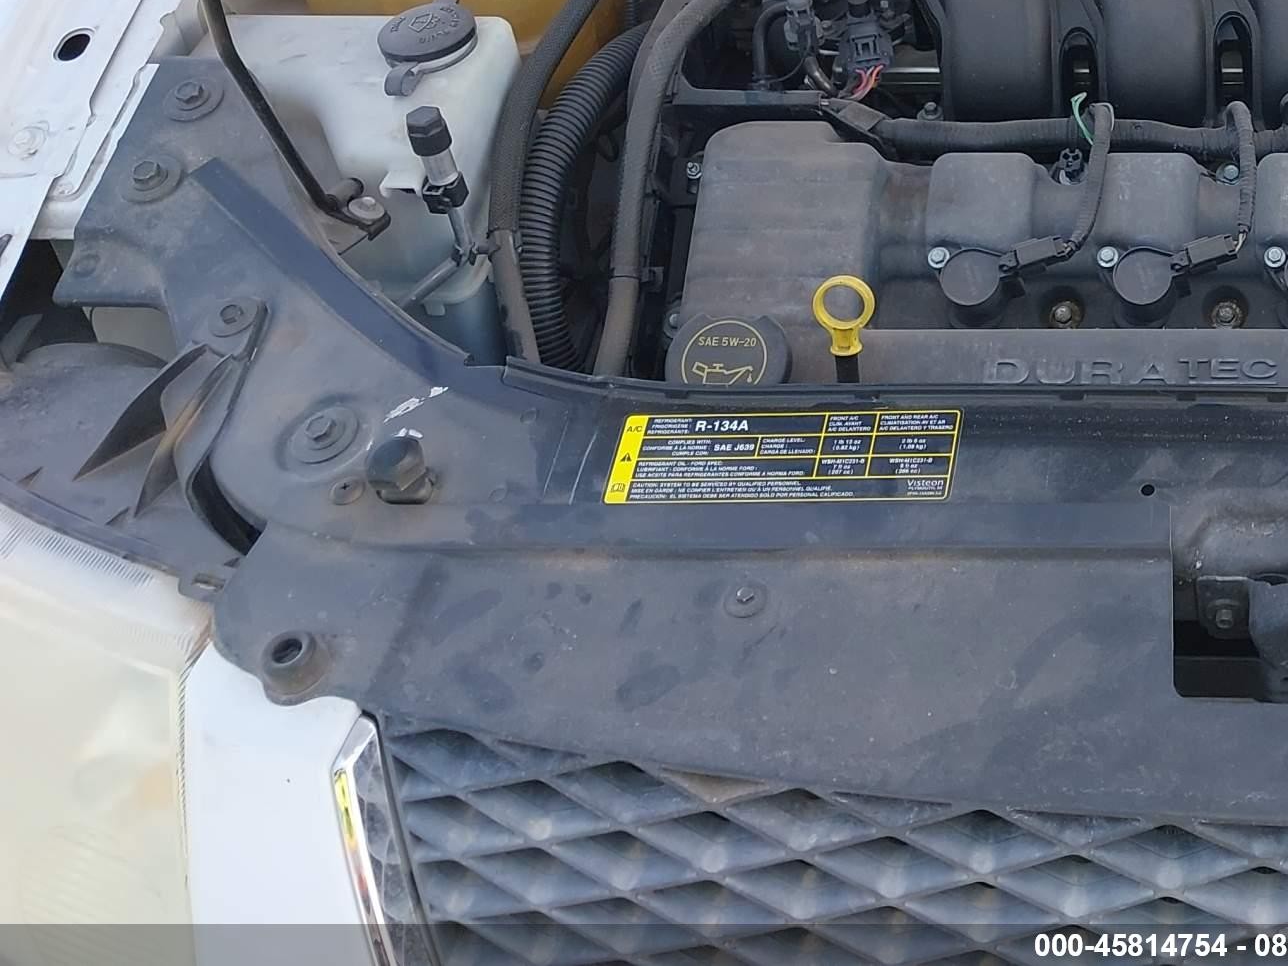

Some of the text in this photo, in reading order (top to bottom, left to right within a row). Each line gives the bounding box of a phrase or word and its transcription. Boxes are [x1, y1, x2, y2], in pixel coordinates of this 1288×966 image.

[698, 336, 756, 346] SAE 5W-20
[694, 420, 749, 432] R-134A
